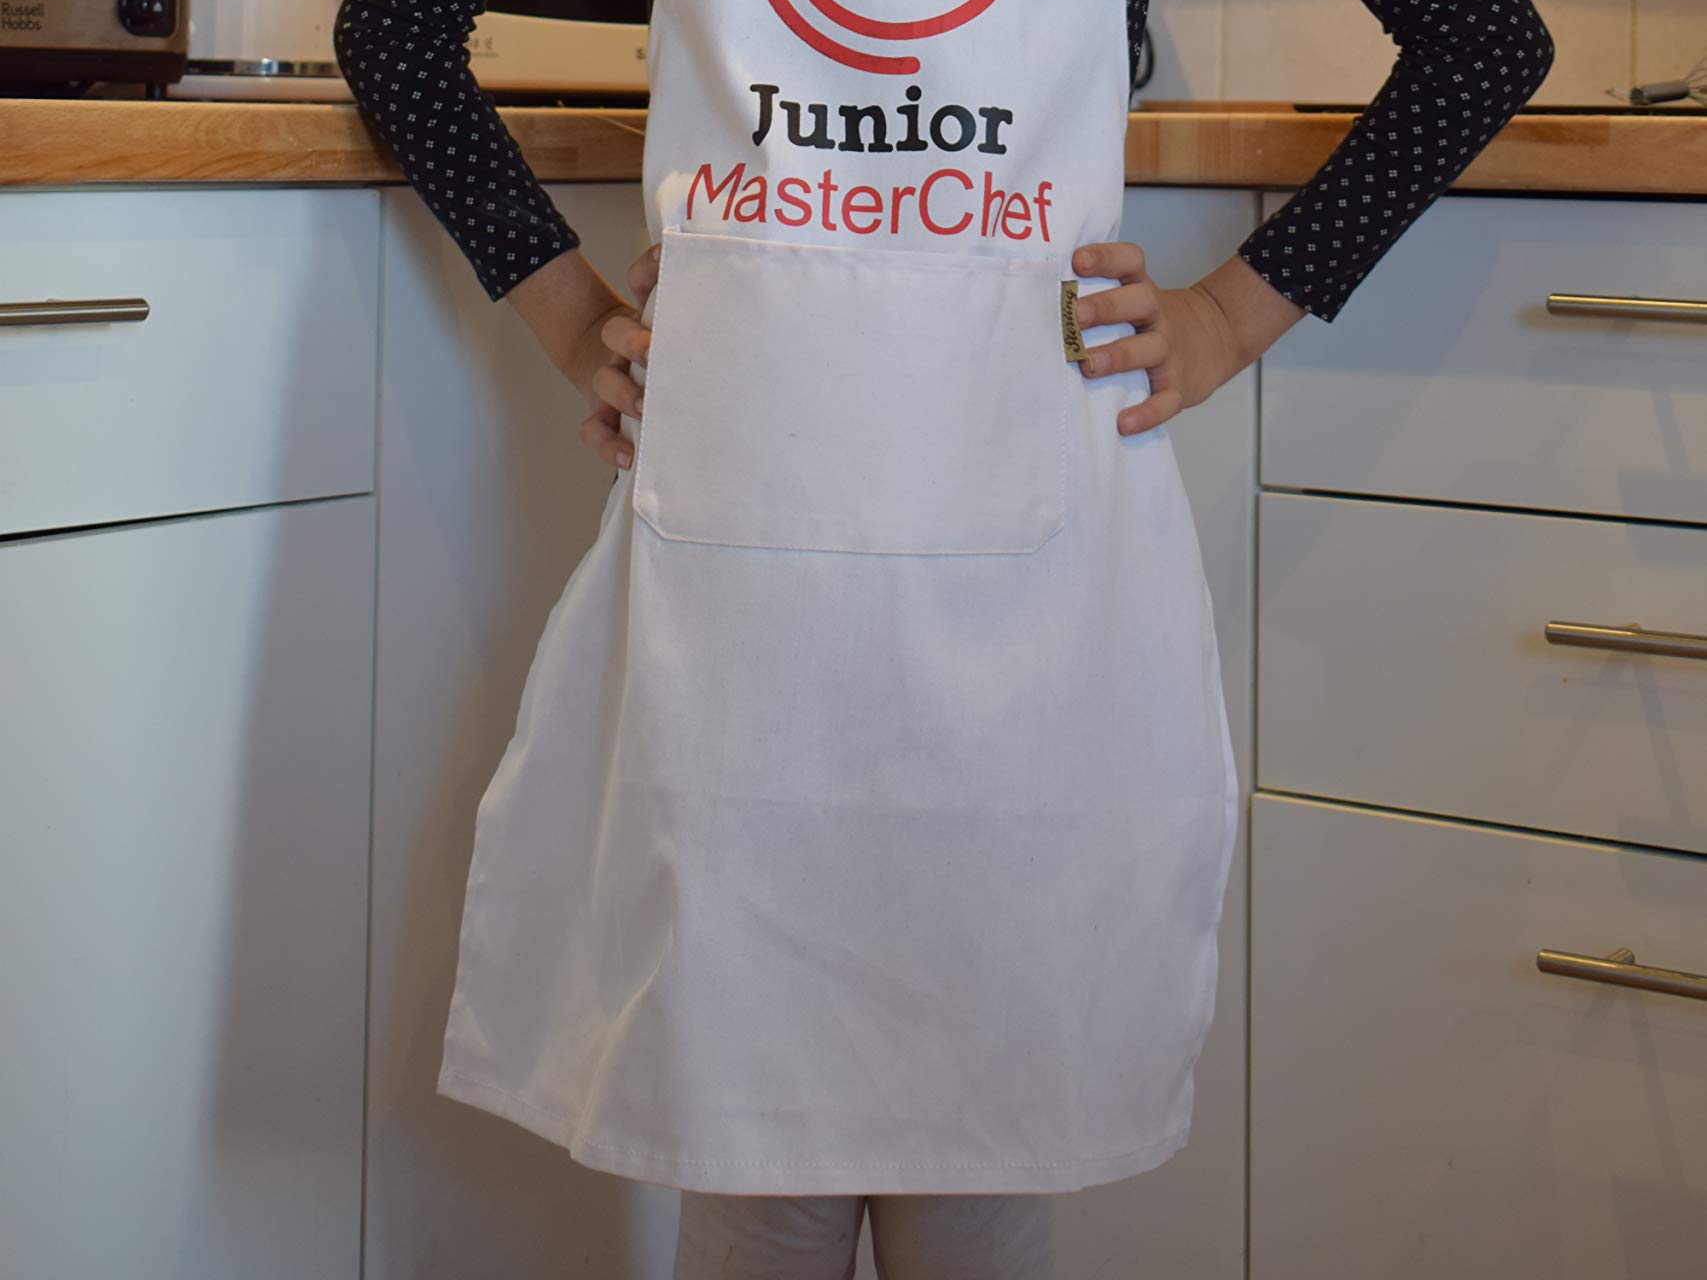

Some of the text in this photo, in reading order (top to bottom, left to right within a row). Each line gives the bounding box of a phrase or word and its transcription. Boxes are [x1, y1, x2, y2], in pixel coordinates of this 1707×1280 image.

[1, 2, 45, 17] Russell
[749, 83, 1014, 156] Junior
[685, 162, 1053, 243] MasterChef
